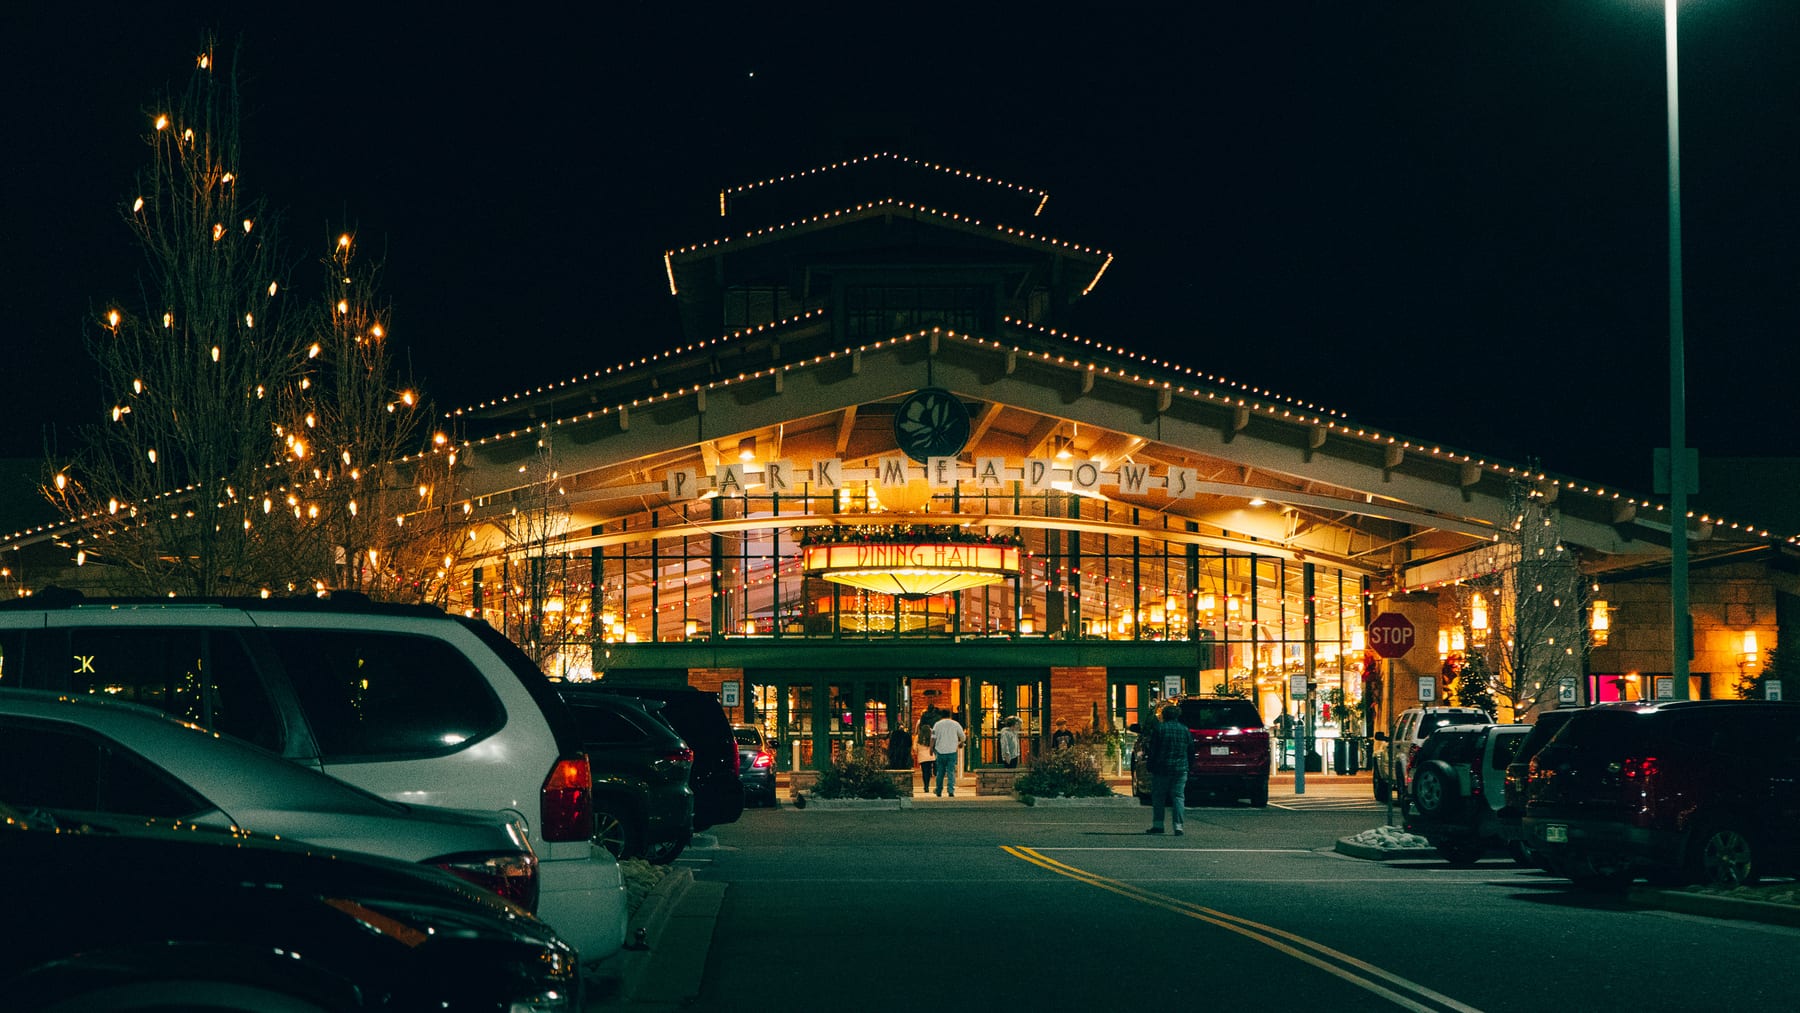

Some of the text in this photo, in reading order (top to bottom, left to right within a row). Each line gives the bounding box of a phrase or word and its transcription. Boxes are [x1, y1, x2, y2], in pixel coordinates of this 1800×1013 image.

[674, 458, 1187, 497] PARK MEADOWS
[857, 545, 923, 567] DINING
[1372, 627, 1413, 644] STOP
